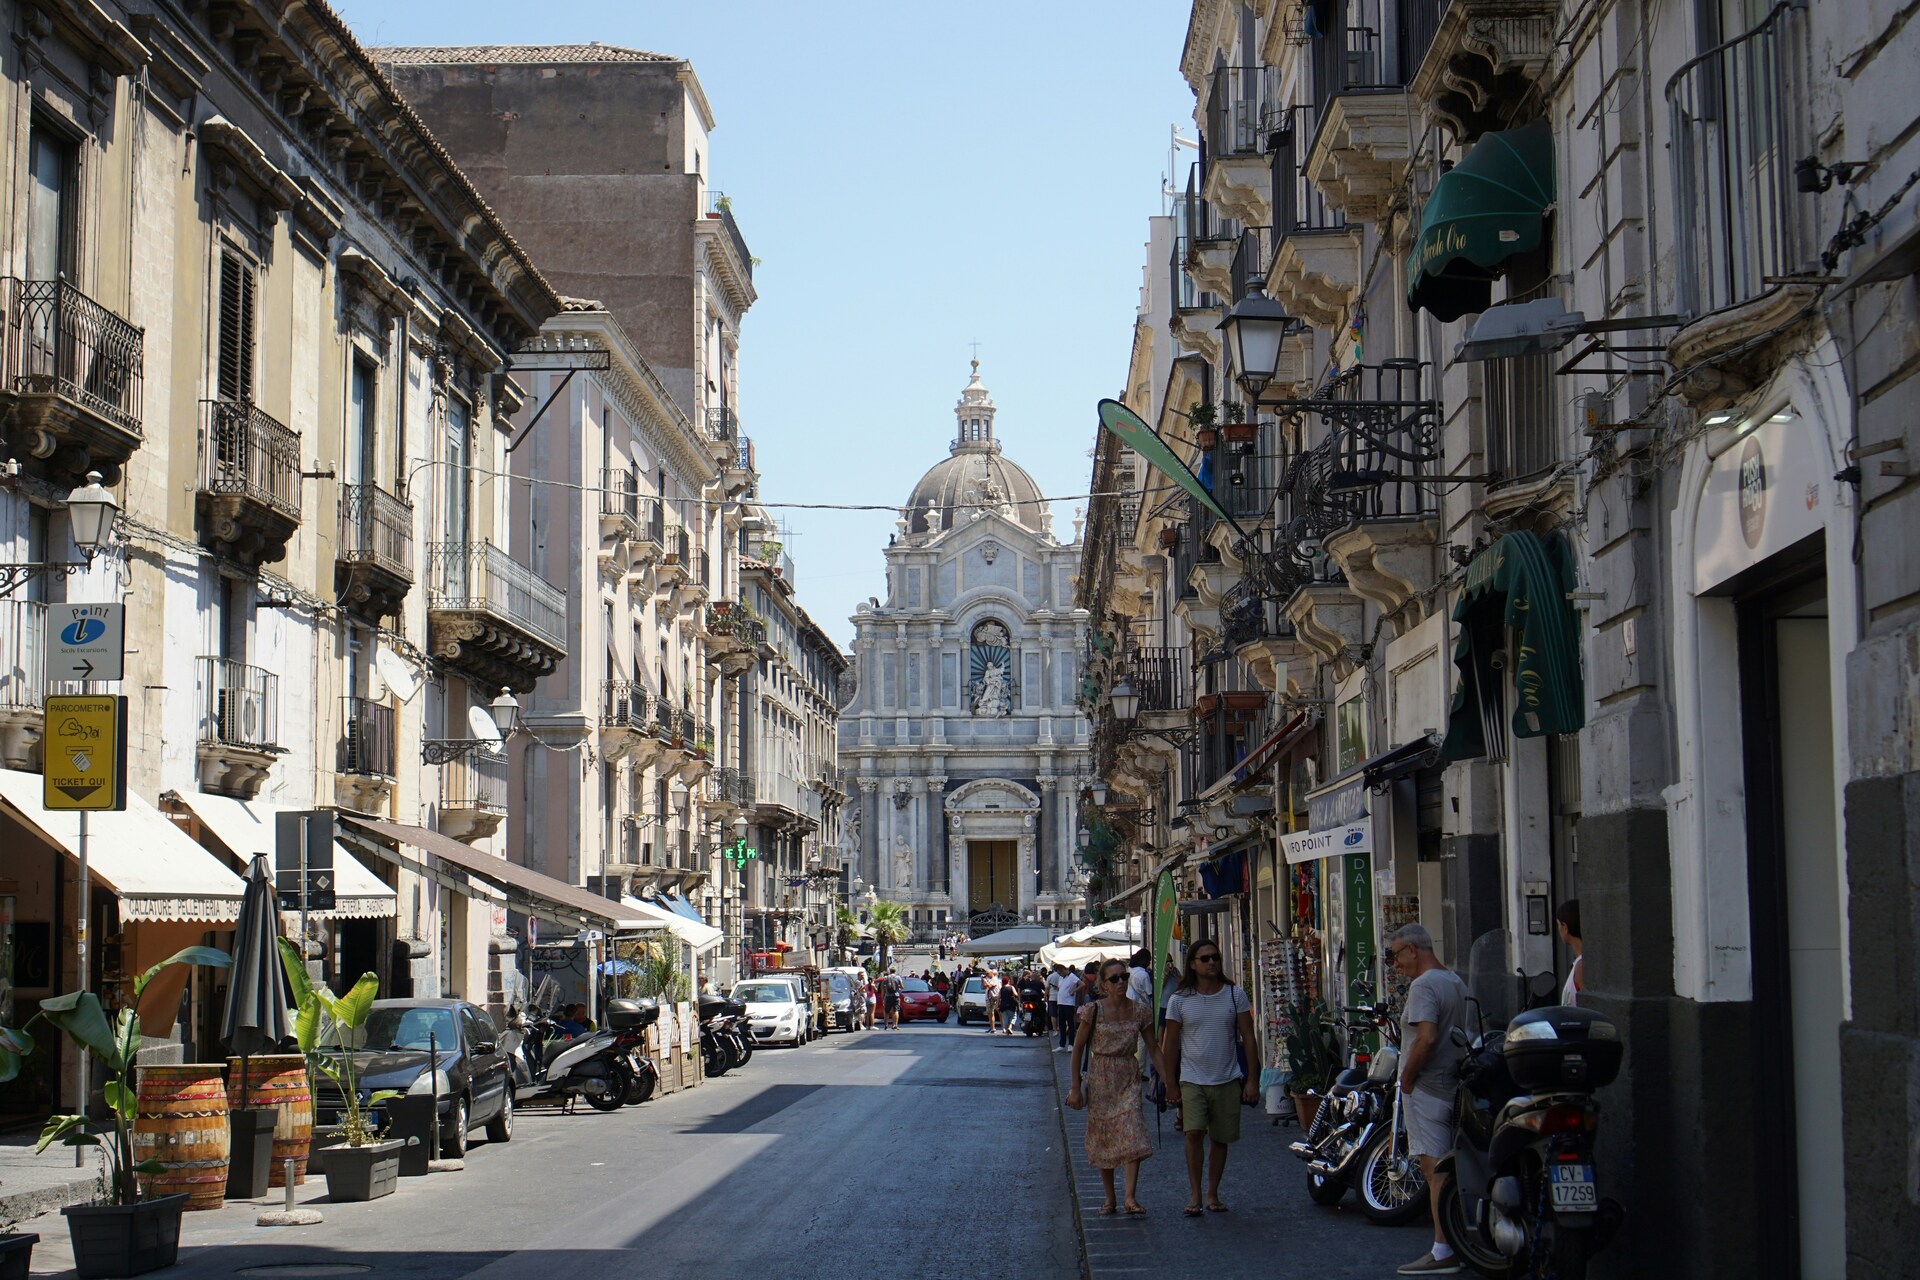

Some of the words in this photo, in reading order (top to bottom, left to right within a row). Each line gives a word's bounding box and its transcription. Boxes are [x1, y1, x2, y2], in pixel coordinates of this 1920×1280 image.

[1446, 222, 1467, 253] Oro
[1743, 453, 1760, 488] PUSH
[1752, 478, 1763, 512] GO
[50, 704, 111, 713] PARCOMETRO
[52, 778, 85, 786] TICKET
[89, 777, 106, 786] QUI
[1301, 835, 1332, 851] POINT
[1353, 858, 1366, 928] DAILY
[129, 898, 172, 916] CALZATURE
[1560, 1166, 1575, 1181] CV
[1555, 1185, 1594, 1201] 17259
